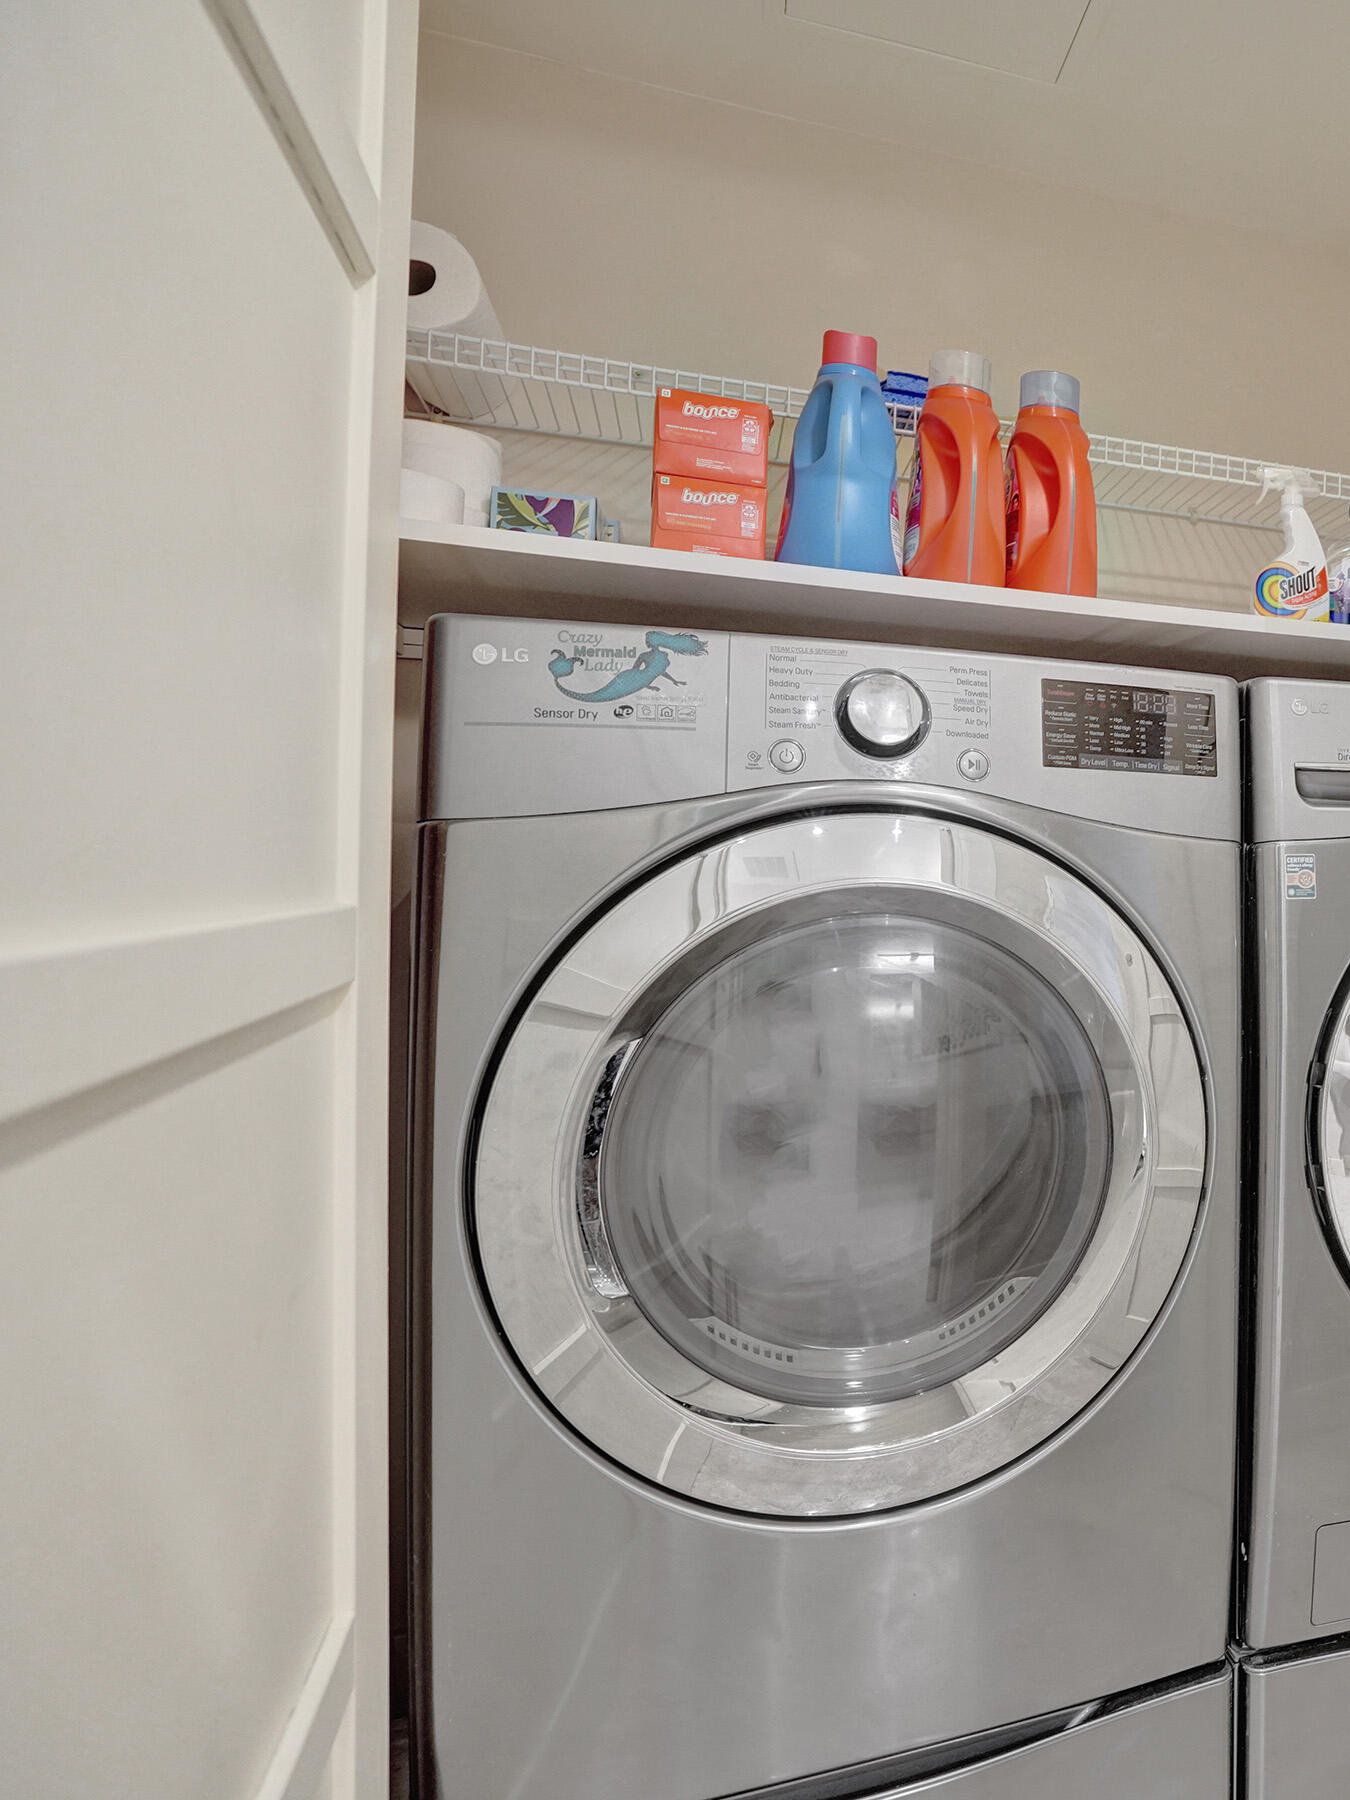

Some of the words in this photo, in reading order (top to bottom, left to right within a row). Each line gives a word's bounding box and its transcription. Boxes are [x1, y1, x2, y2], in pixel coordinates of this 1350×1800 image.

[682, 401, 739, 419] bounce
[682, 488, 739, 505] bounce
[1279, 566, 1315, 599] SHOUT
[557, 630, 604, 648] Crazy
[502, 648, 528, 663] LG
[573, 645, 637, 659] Mermaid
[769, 654, 796, 662] Normal
[584, 659, 624, 674] Lady
[769, 666, 793, 674] Heavy
[795, 667, 813, 676] Duty
[949, 666, 967, 674] Perm
[969, 668, 988, 676] Press
[769, 680, 800, 689] Bedding
[957, 678, 988, 687] Delicates
[964, 689, 988, 698] Towels
[534, 707, 574, 719] Sensor
[578, 708, 599, 721] Dry
[768, 706, 791, 714] Steam
[953, 704, 975, 713] Speed
[976, 706, 988, 714] Dry
[768, 720, 793, 729] Steam
[976, 719, 989, 728] Dry
[945, 729, 989, 739] Downloaded
[1112, 760, 1129, 768] Temp.
[1148, 762, 1157, 770] Dry
